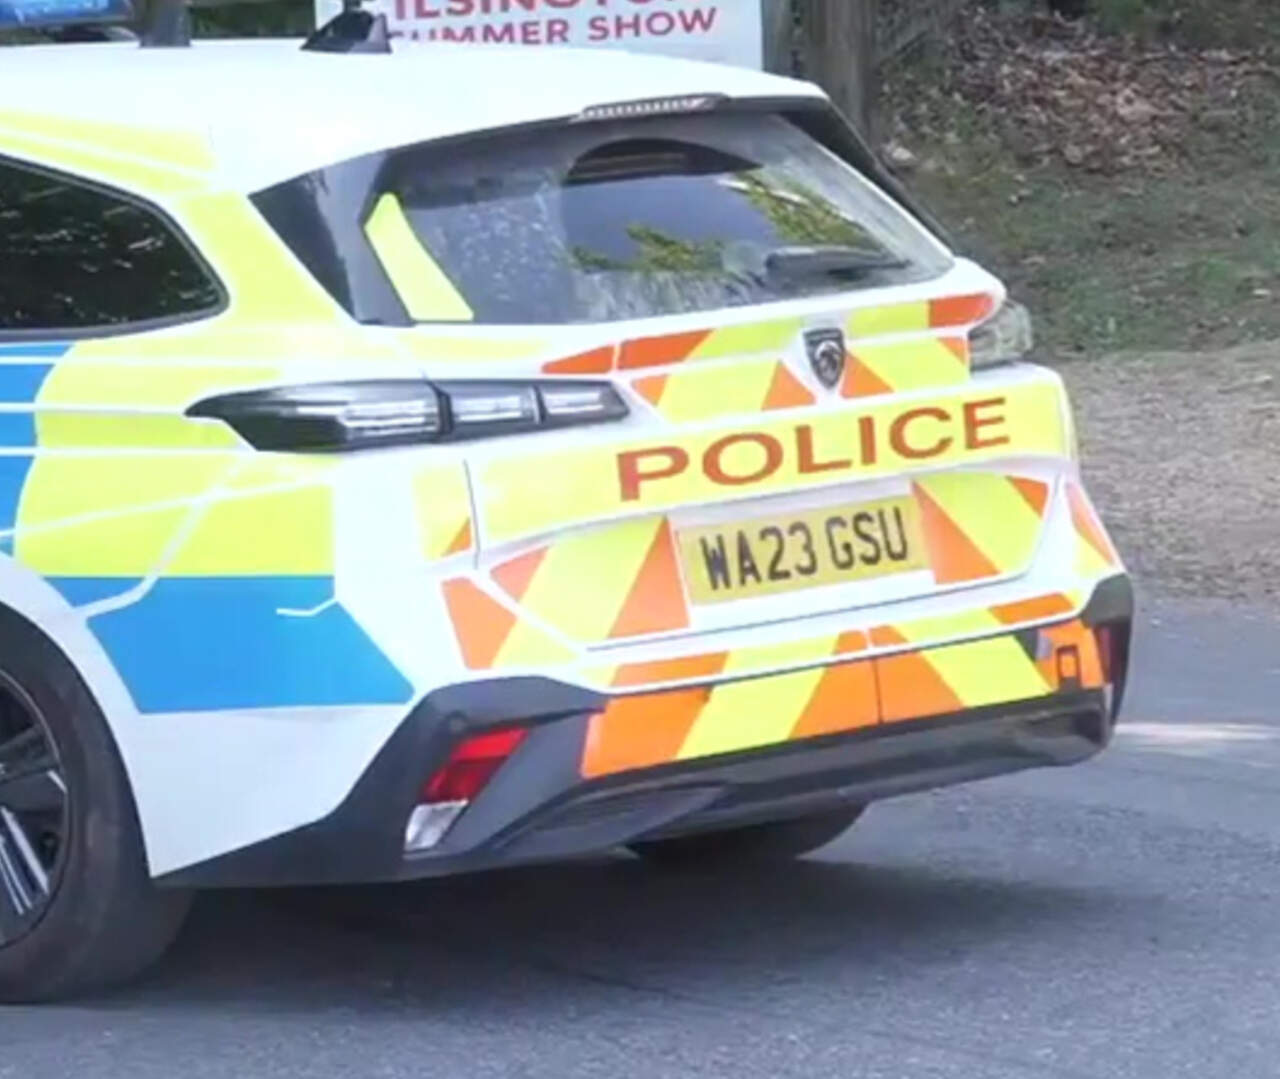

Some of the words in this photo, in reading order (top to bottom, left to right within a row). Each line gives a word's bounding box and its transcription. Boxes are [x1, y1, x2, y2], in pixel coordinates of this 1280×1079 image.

[388, 18, 570, 45] MMER
[587, 6, 717, 42] SHOW
[615, 396, 1011, 502] POLICE
[699, 522, 818, 591] WA23
[824, 505, 909, 570] GSU
